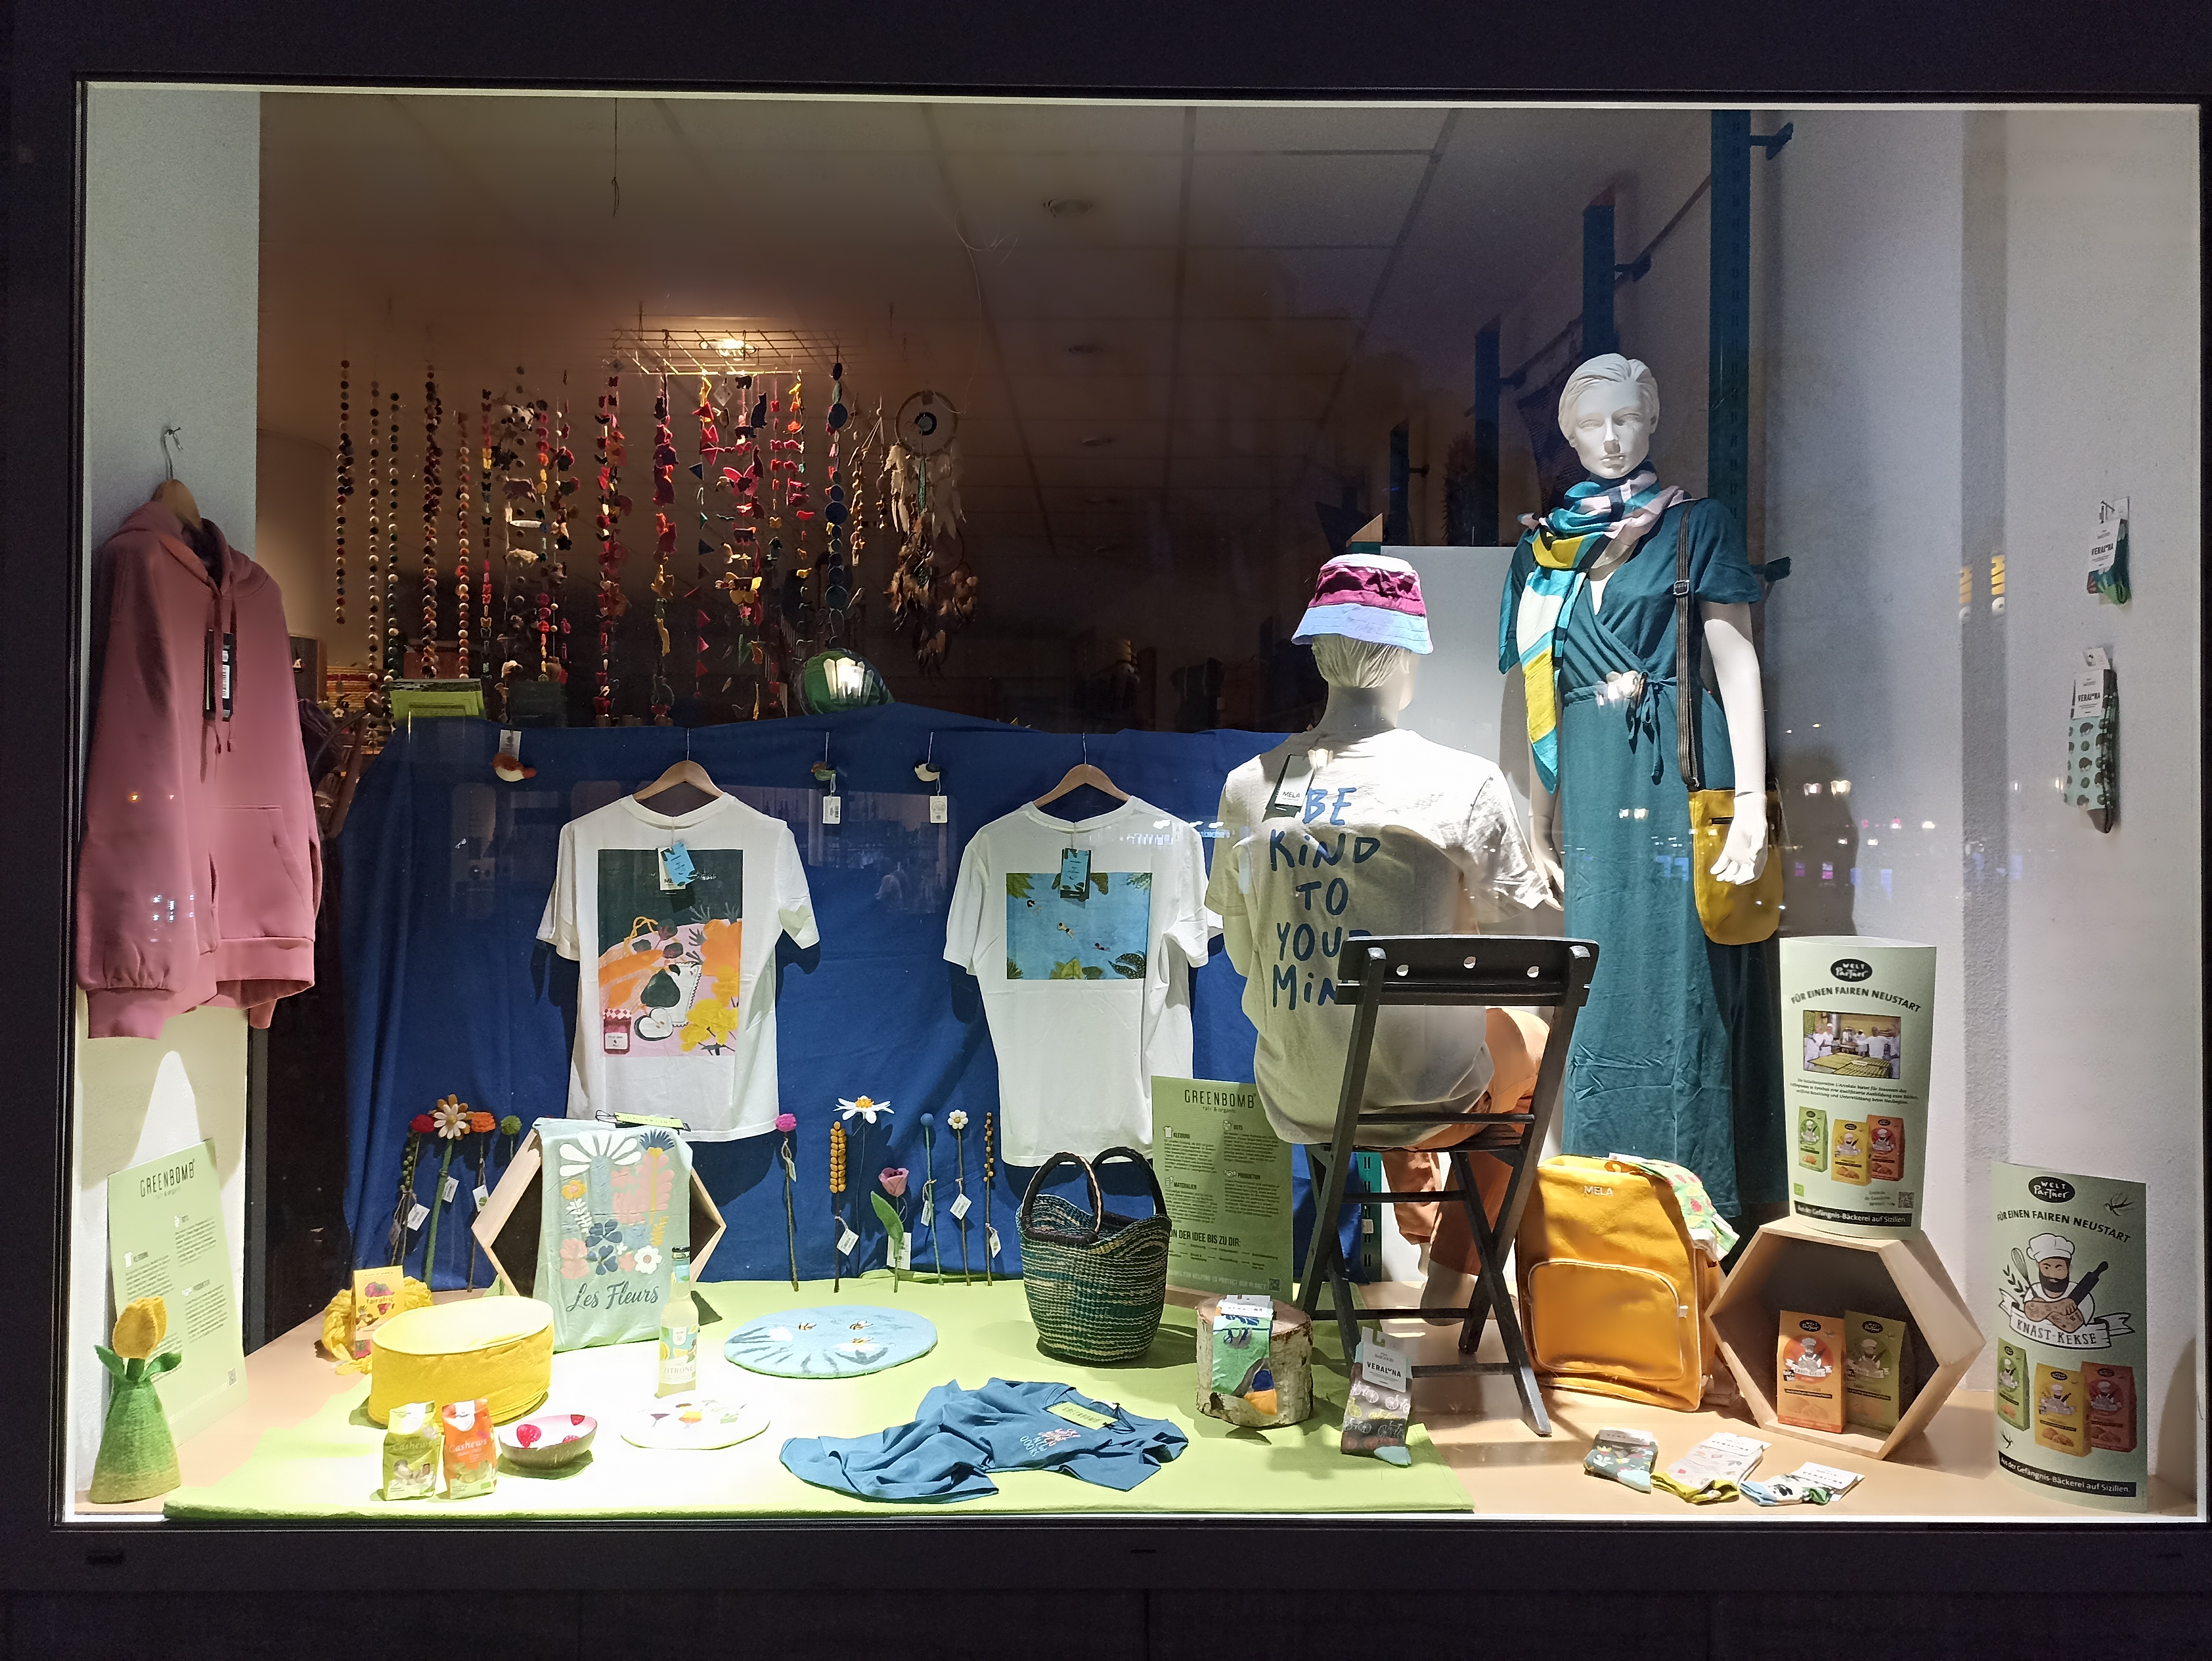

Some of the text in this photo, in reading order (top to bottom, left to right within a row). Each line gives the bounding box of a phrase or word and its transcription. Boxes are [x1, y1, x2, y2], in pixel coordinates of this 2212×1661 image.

[1302, 787, 1357, 825] BE
[1295, 877, 1349, 916] TO
[1277, 922, 1372, 961] YOU
[1791, 986, 1921, 1012] FÜR EINEN FAIREN NEUSTART
[1184, 1089, 1254, 1108] GREENBOMB
[140, 1162, 194, 1197] GREENBOMB
[1584, 1185, 1614, 1196] MELA
[2041, 1181, 2066, 1189] WELT
[1812, 1208, 1870, 1222] Gefängnis-Bäckerei
[1997, 1209, 2131, 1242] FÜR EINEN FAIREN NEUSTART
[1179, 1230, 1191, 1240] DER
[1192, 1232, 1206, 1242] IDEE
[1207, 1234, 1218, 1244] BIS
[1219, 1236, 1227, 1245] ZU
[566, 1280, 659, 1312] Les Fleurs
[2016, 1319, 2097, 1344] KNAST-KEKSE
[663, 1364, 693, 1374] ZITRONE
[393, 1440, 432, 1451] Cashews
[449, 1438, 487, 1453] Cashews
[2008, 1462, 2016, 1470] der
[2017, 1465, 2085, 1488] Gefängnis-Bäckerei
